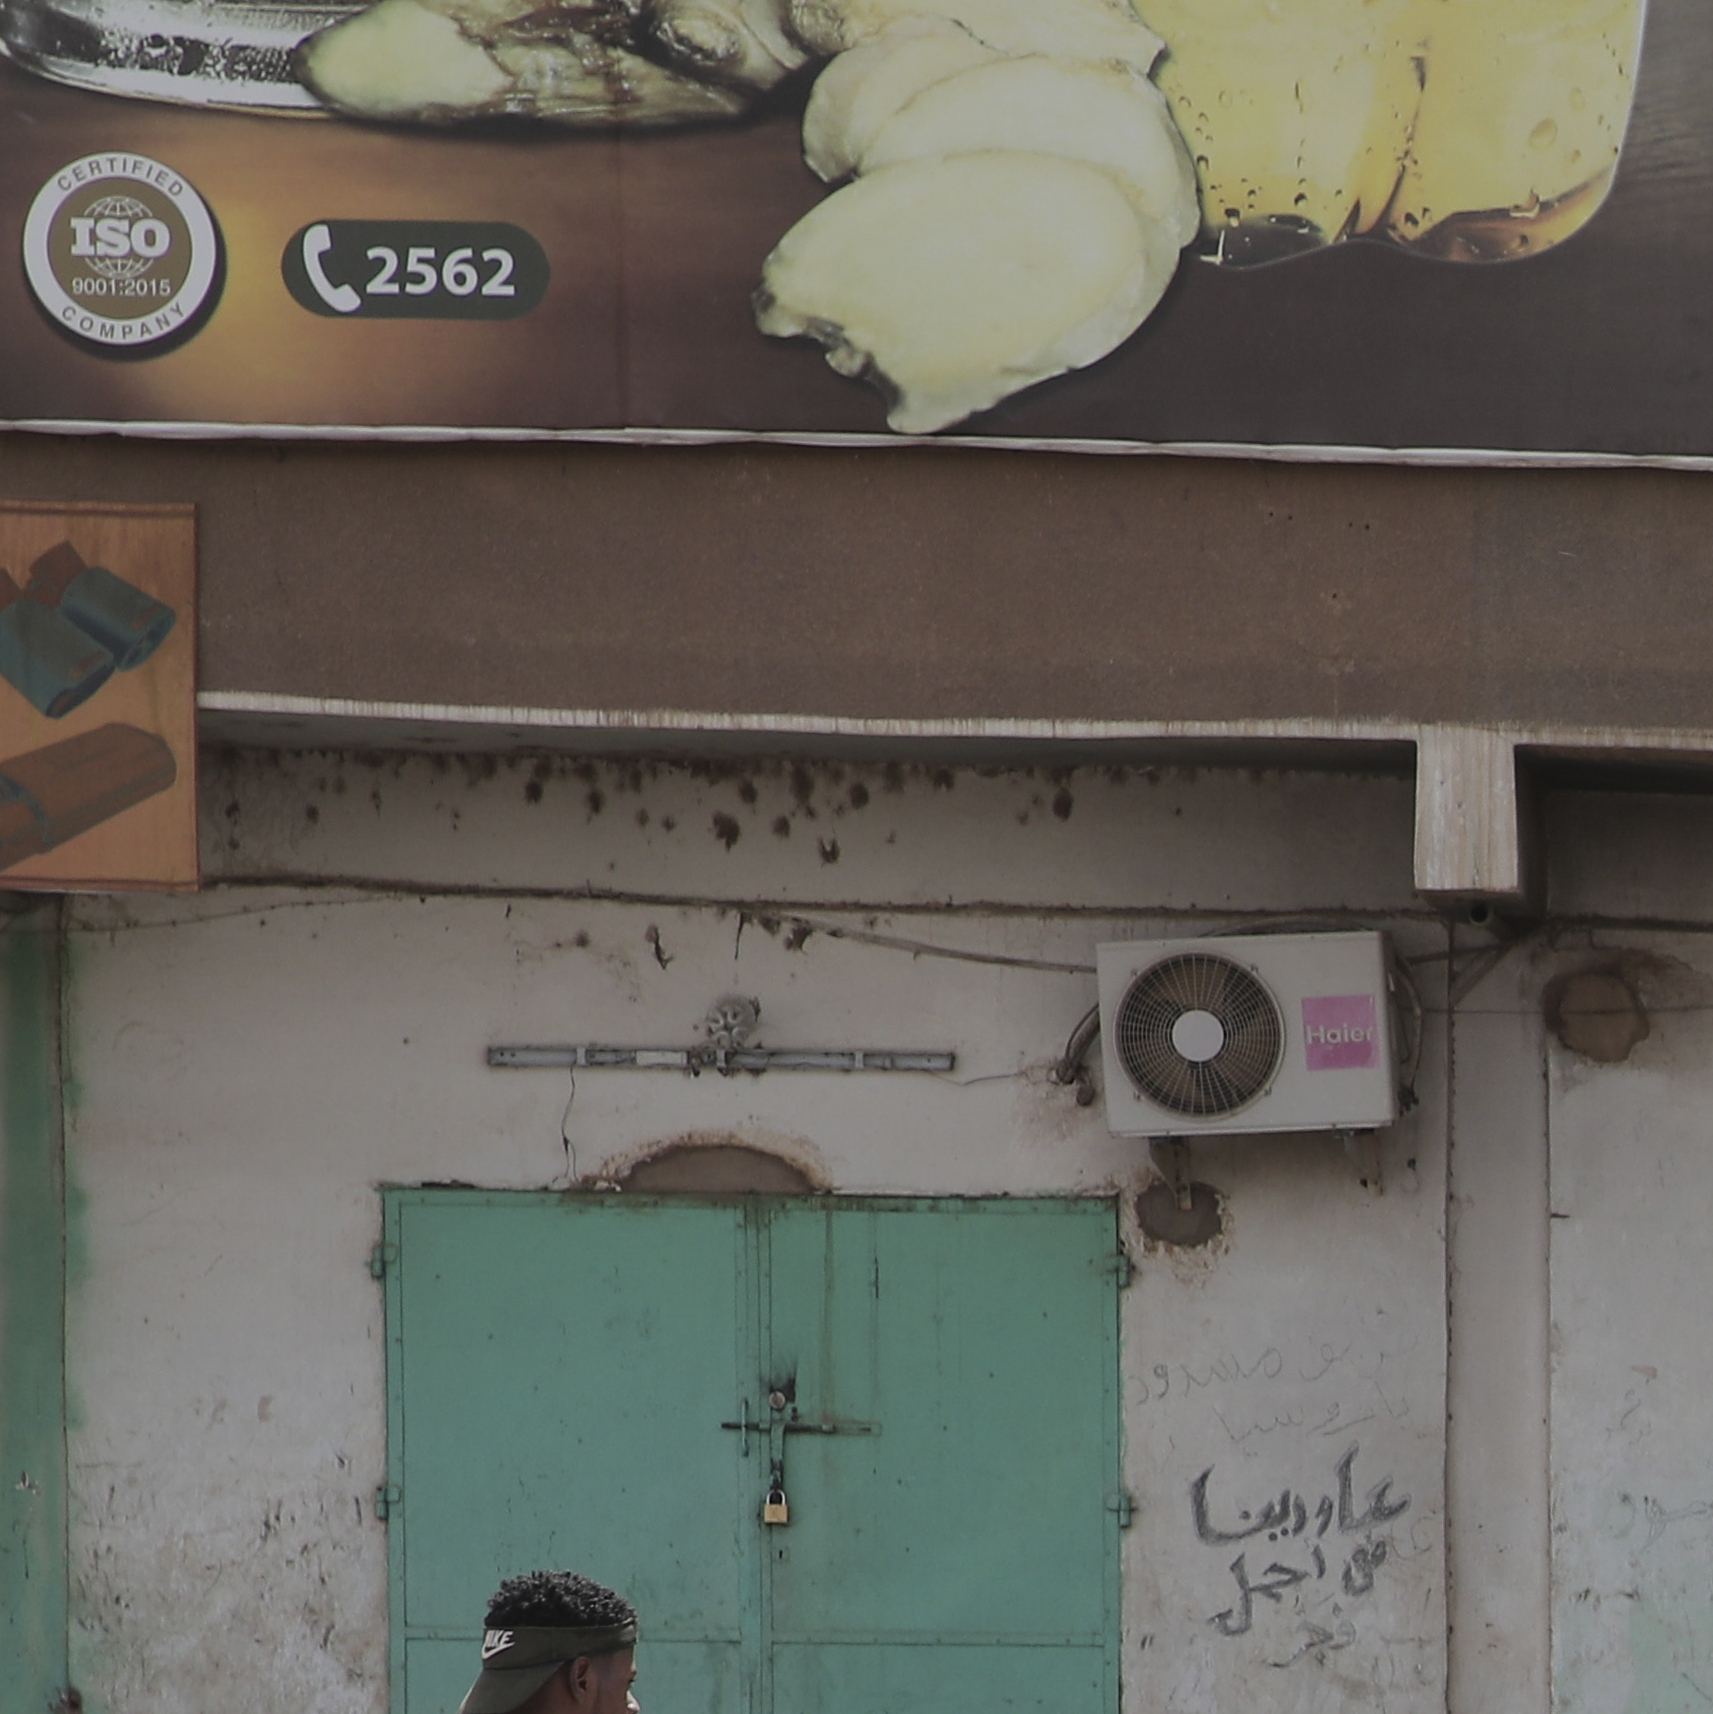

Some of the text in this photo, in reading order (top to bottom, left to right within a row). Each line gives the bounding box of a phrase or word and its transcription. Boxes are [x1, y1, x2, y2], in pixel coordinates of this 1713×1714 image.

[57, 157, 184, 197] CERTIFIED
[70, 217, 171, 259] ISO
[71, 277, 172, 297] 9001:2015
[366, 246, 516, 297] 2562
[62, 302, 184, 340] COMPANY
[1305, 1023, 1374, 1046] Haier
[485, 1629, 514, 1648] NIKE
